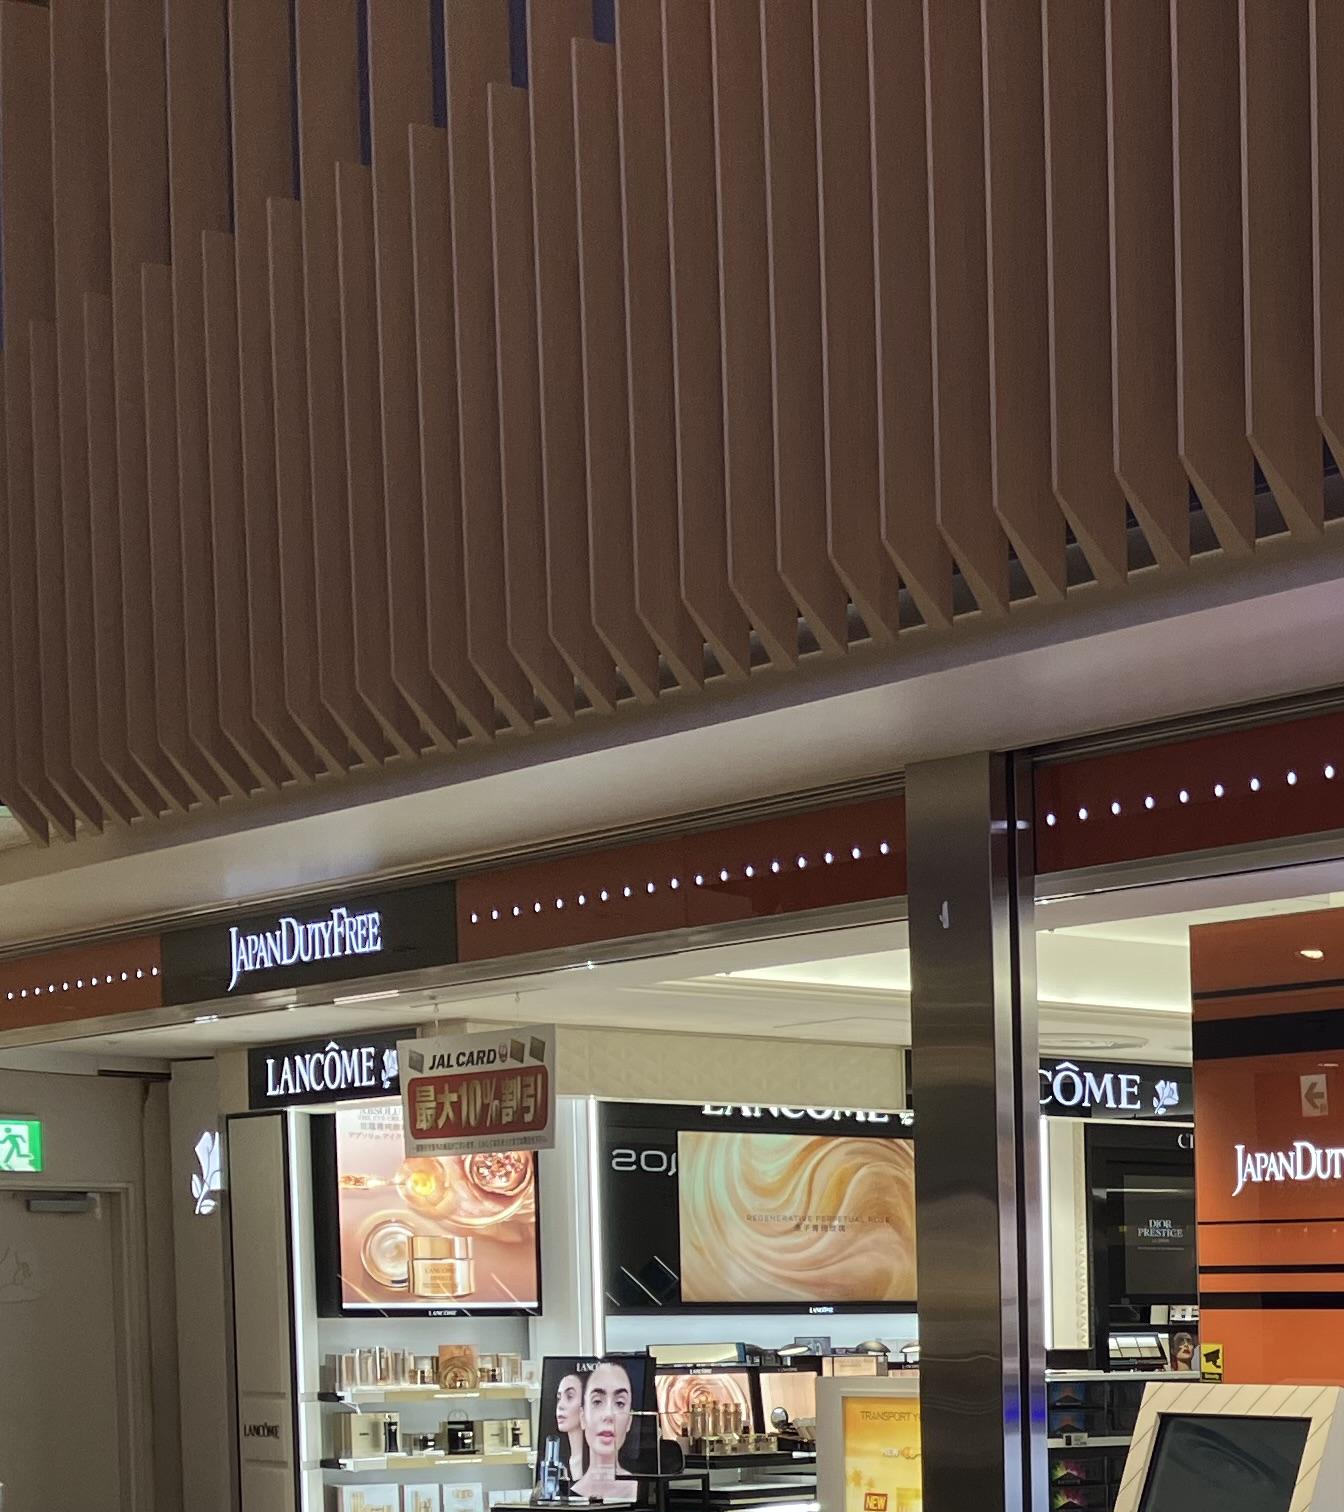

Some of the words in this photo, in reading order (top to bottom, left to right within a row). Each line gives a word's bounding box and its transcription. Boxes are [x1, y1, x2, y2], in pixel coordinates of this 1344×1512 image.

[266, 1040, 376, 1097] LANCÔME
[415, 1073, 542, 1131] 最大10%割引
[746, 1215, 813, 1223] REGENERATIVE
[815, 1215, 866, 1223] PERPETUAL
[1148, 1219, 1172, 1229] DIOR
[1137, 1228, 1183, 1238] PRESTIGE
[859, 1410, 911, 1422] TRANSPORT
[866, 1494, 887, 1510] NEW
